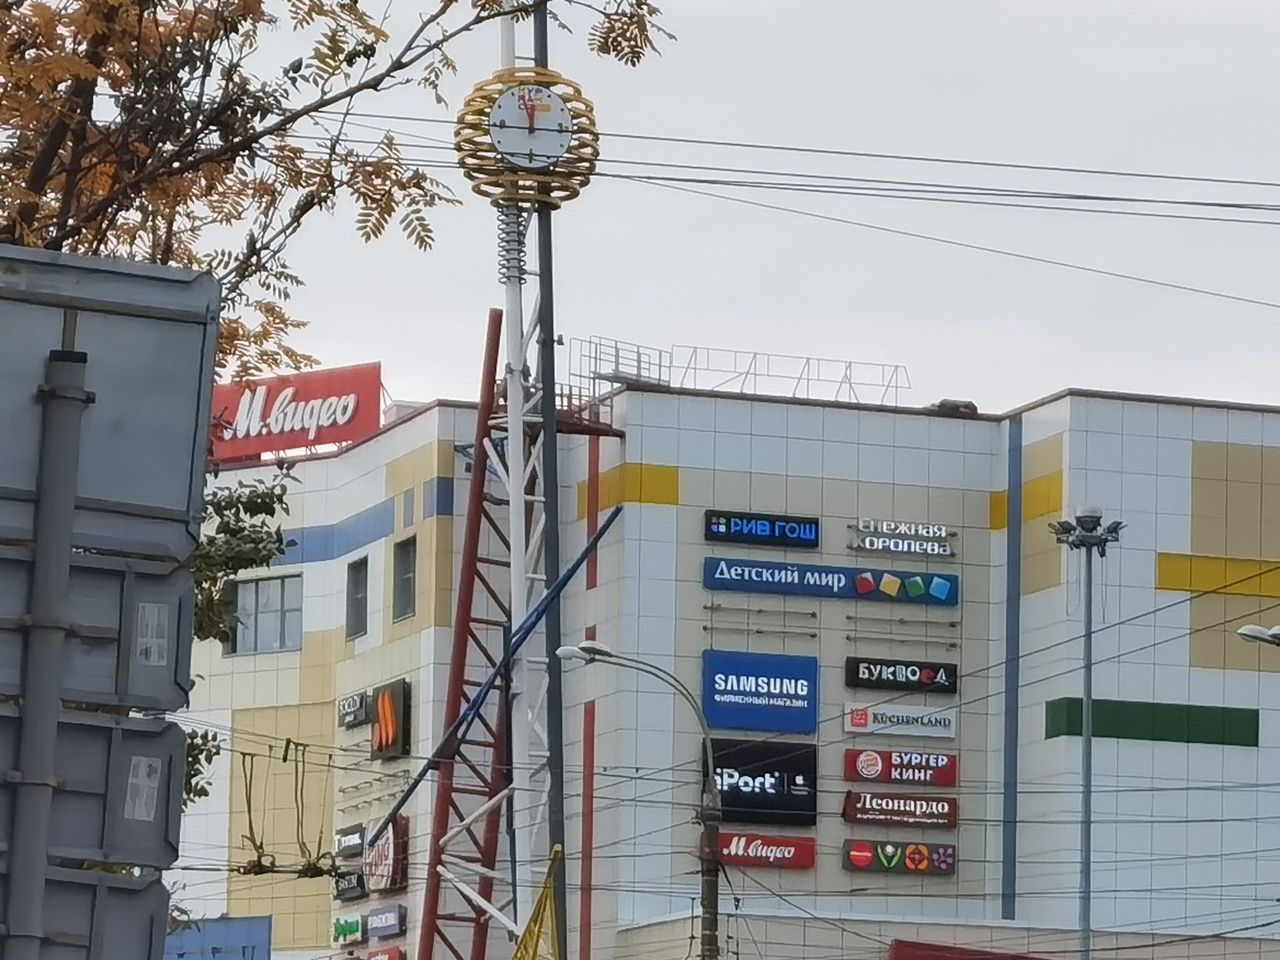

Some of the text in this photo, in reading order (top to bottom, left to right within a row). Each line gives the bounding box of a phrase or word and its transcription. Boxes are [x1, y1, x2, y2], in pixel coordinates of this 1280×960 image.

[731, 518, 816, 540] РИВ ГОШ
[714, 560, 846, 592] Детский мир
[714, 673, 808, 695] SAMSUNG
[891, 752, 948, 767] БУРГЕР
[891, 766, 934, 782] КИНГ
[856, 793, 949, 816] Леонардо
